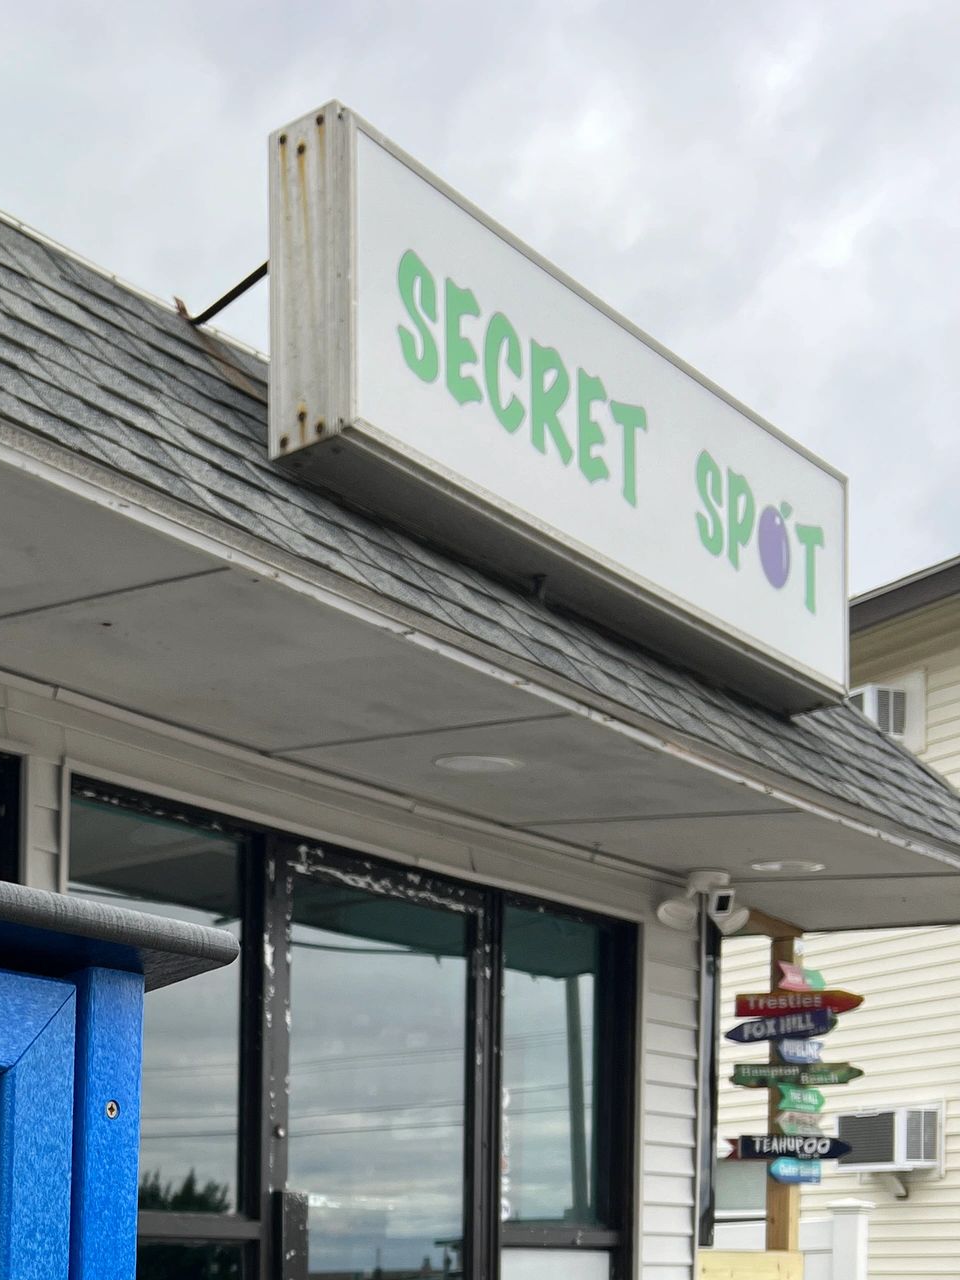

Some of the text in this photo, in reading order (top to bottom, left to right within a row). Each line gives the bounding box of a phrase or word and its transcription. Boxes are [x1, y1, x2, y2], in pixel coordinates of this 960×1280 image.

[398, 249, 824, 614] SECRET SPOT
[743, 1022, 776, 1040] FOX
[780, 1014, 815, 1034] HILL
[752, 1137, 830, 1155] TEAHUPOO
